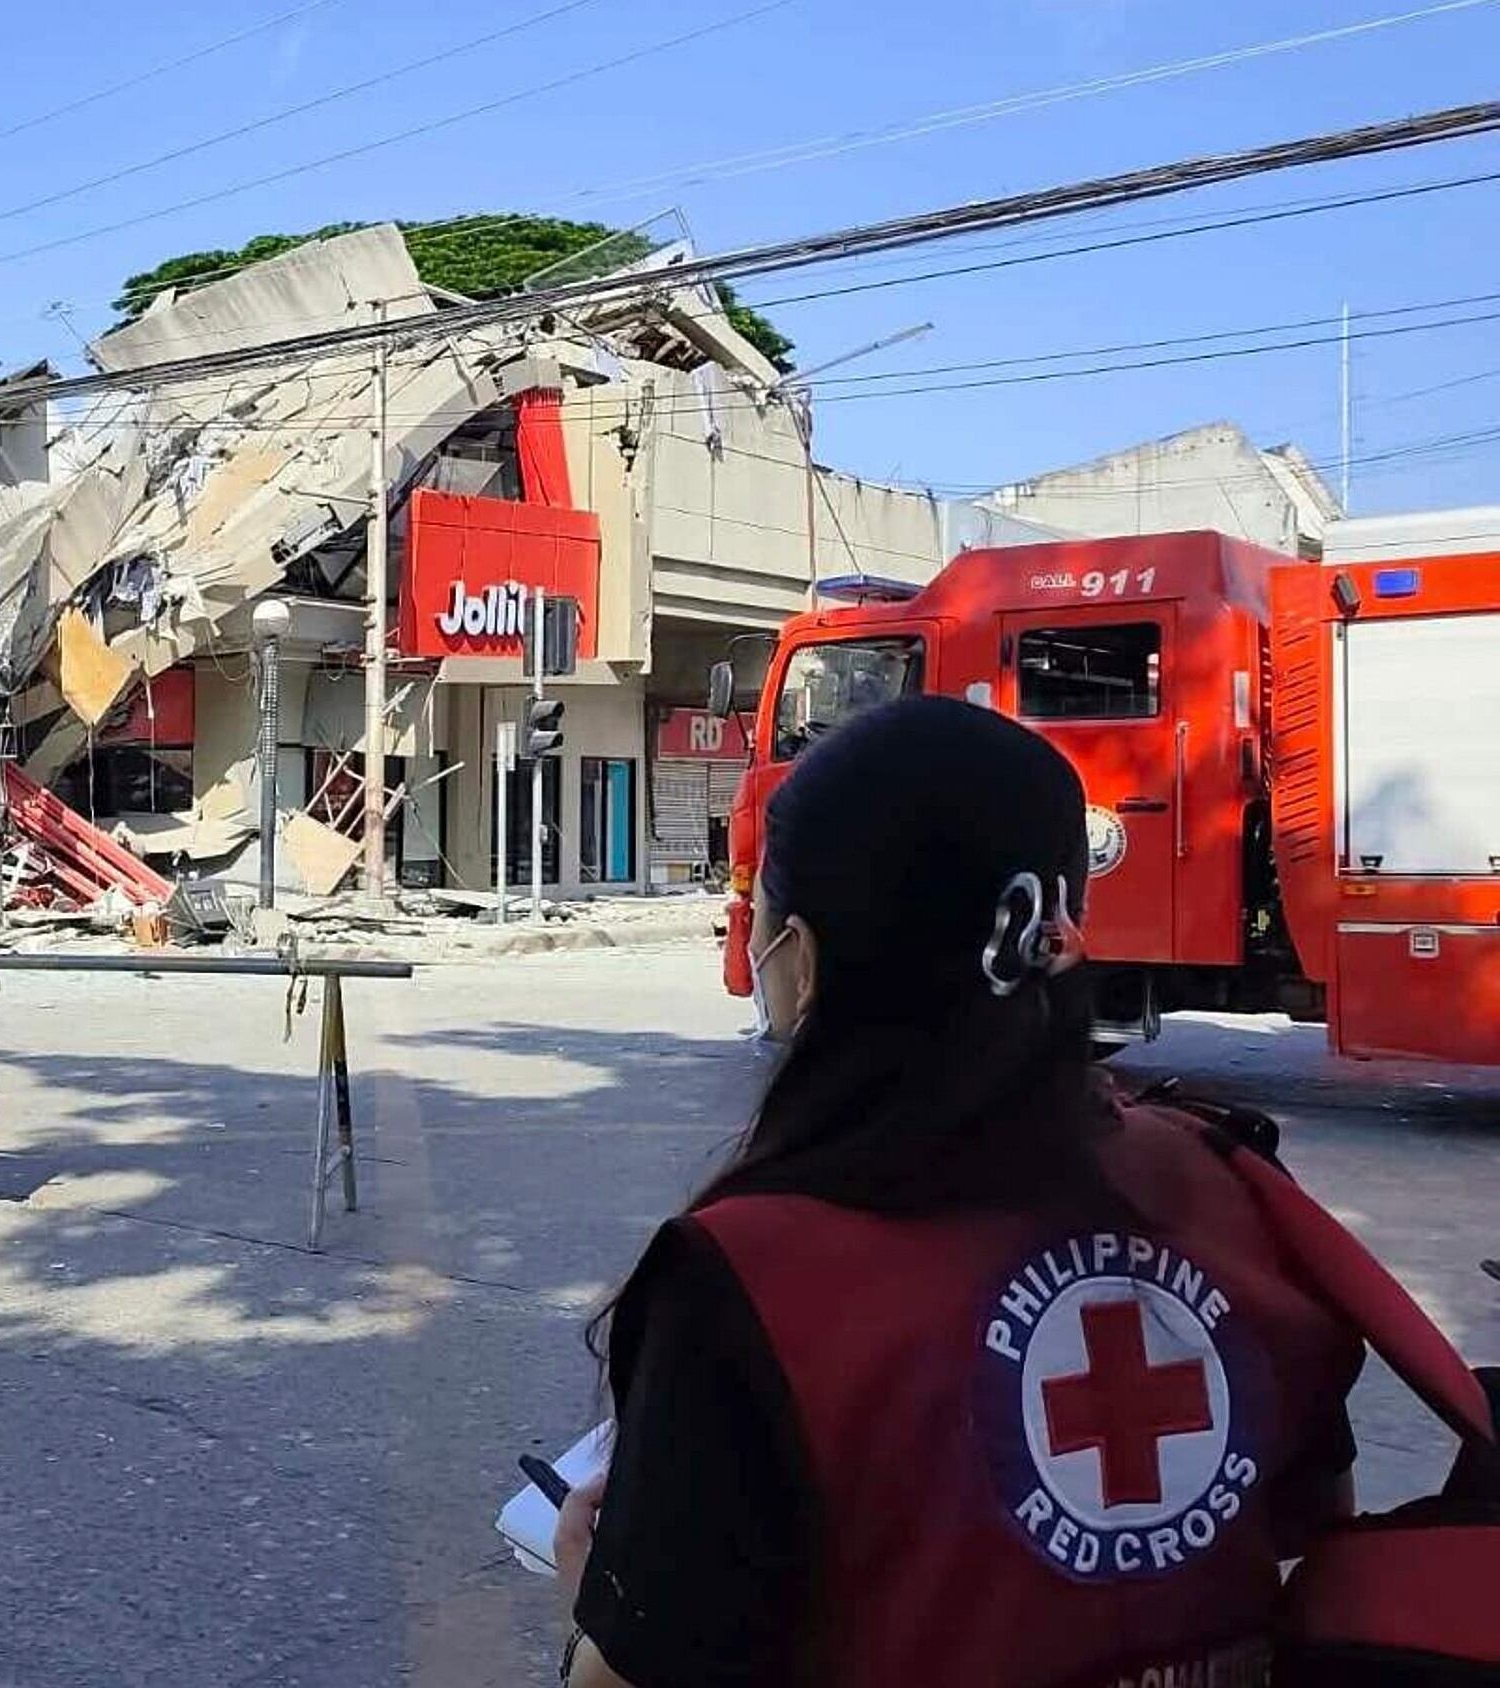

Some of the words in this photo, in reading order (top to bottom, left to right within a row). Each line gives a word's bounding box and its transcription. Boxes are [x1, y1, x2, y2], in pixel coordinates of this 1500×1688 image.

[1031, 572, 1077, 589] CALL
[1080, 567, 1156, 597] 911
[986, 1233, 1231, 1361] PHILIPPINE
[1014, 1488, 1100, 1573] RED
[1114, 1452, 1257, 1573] CROSS
